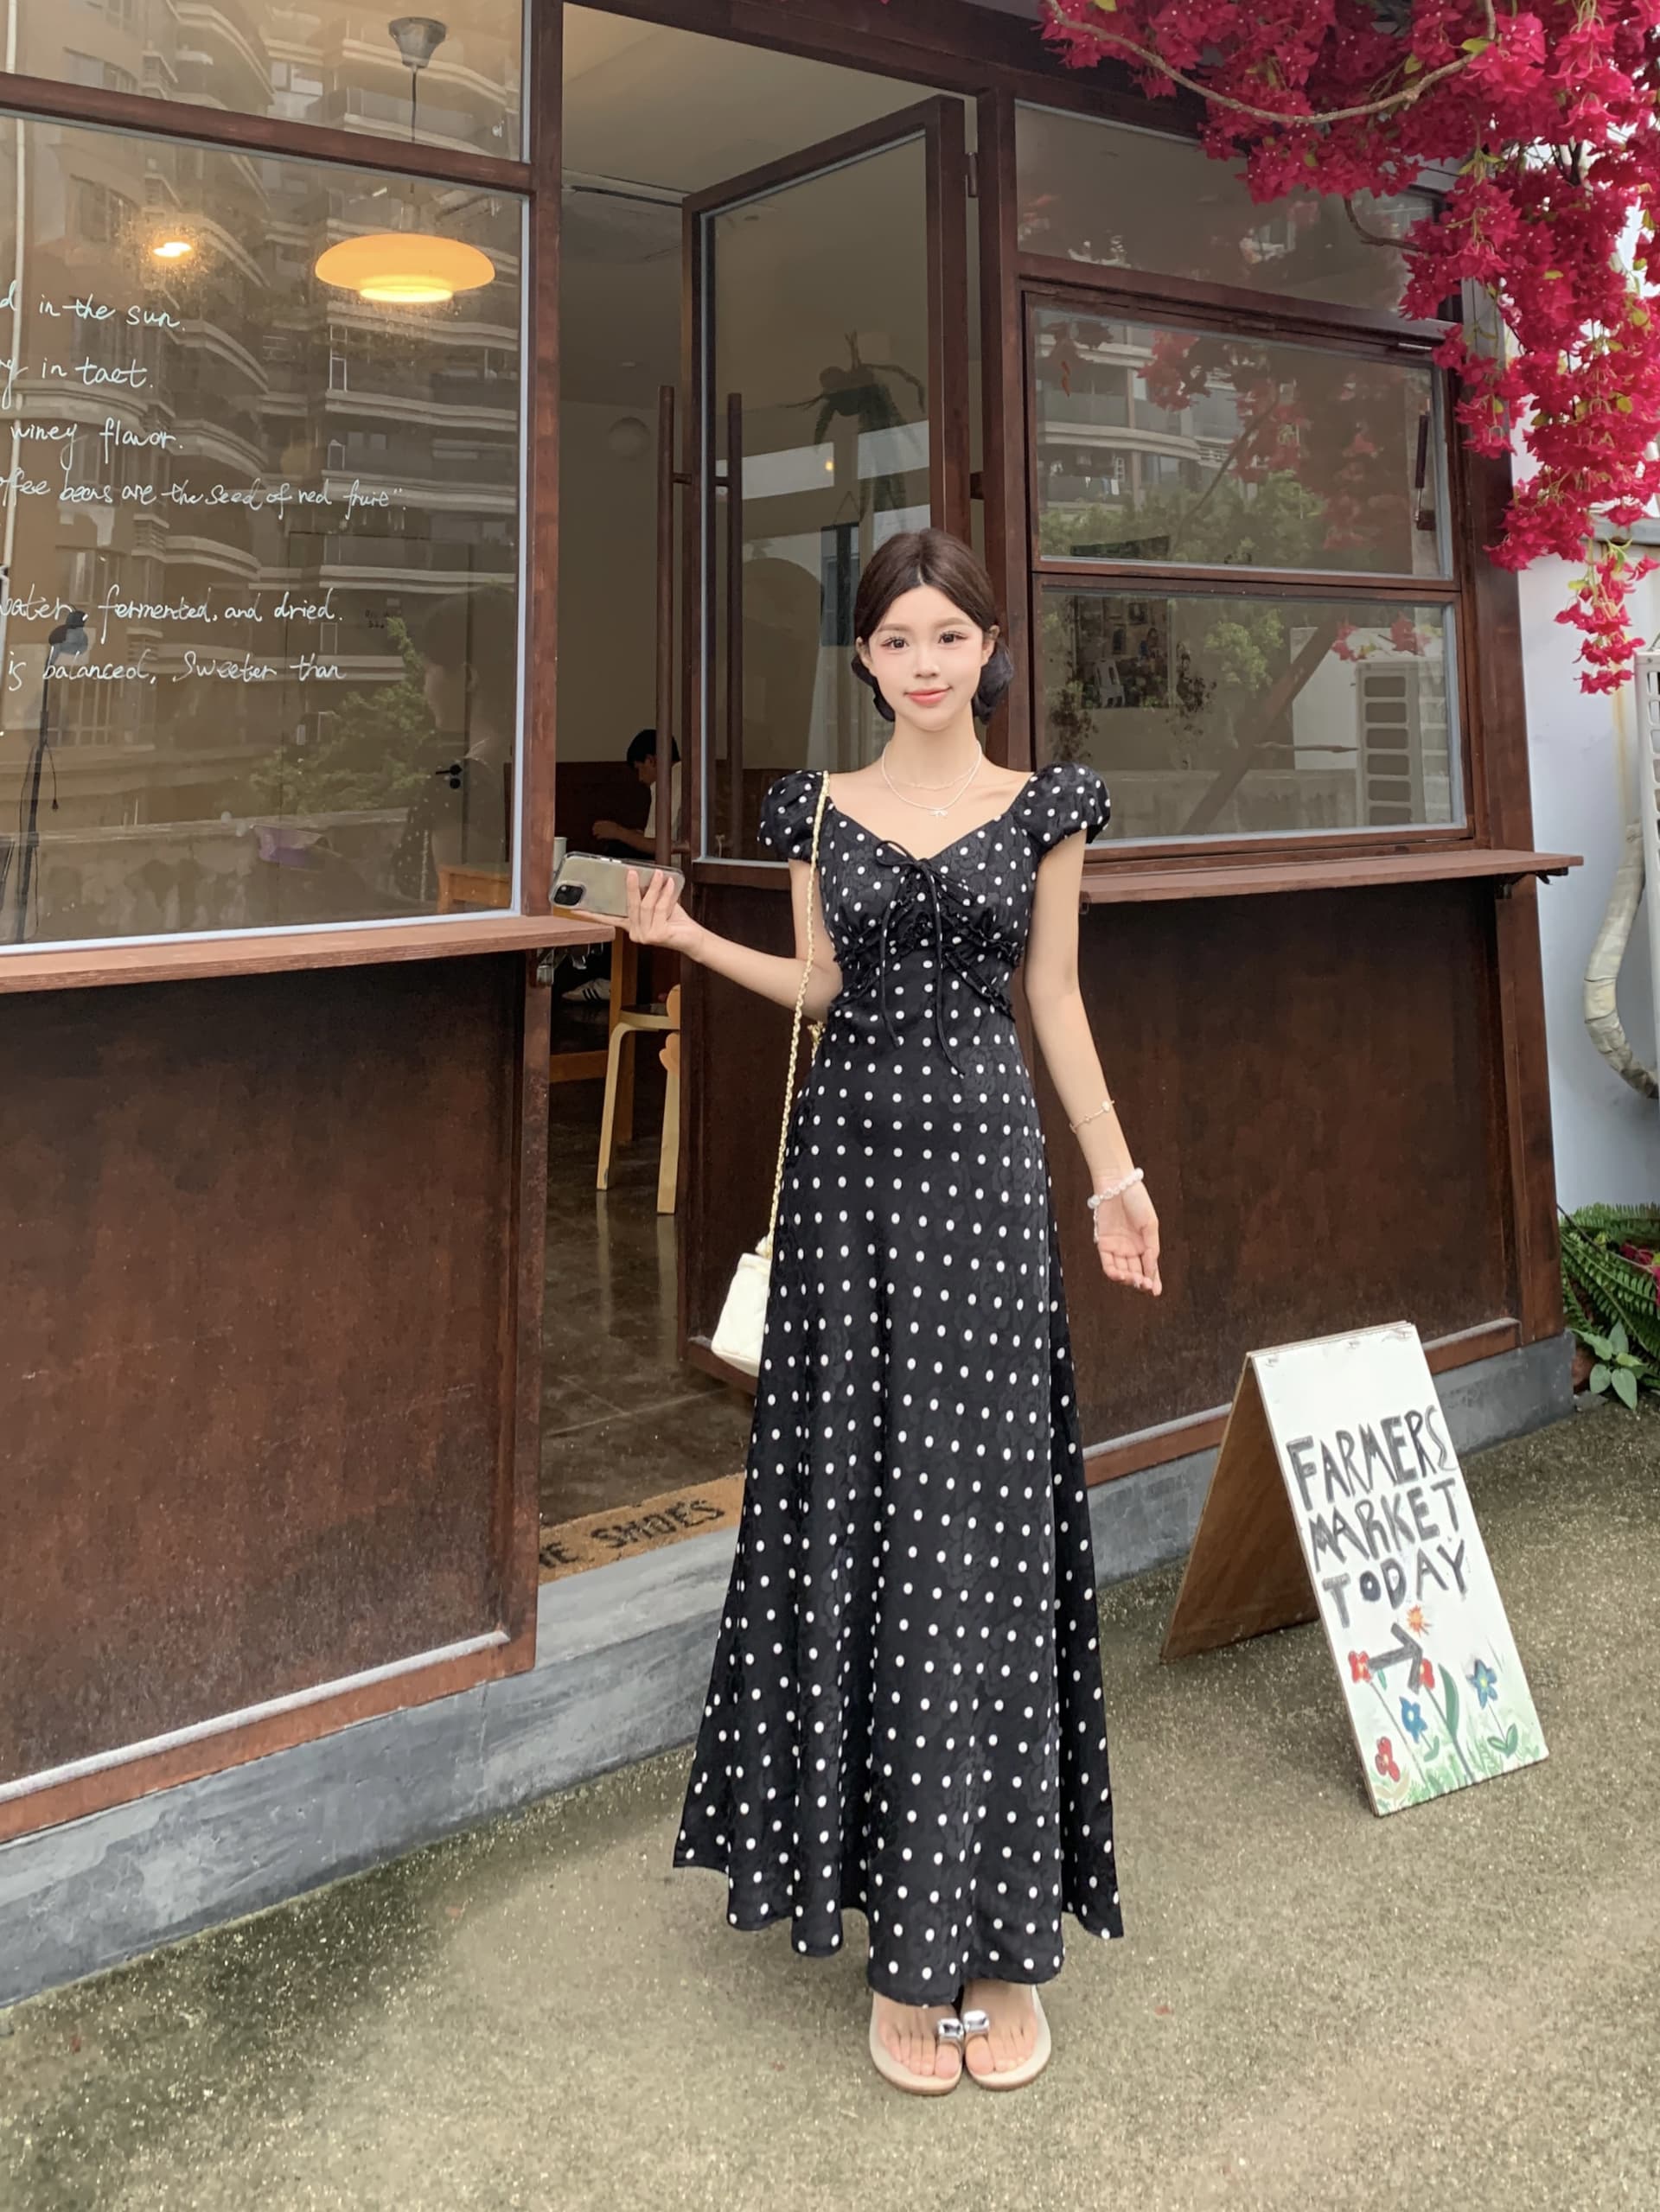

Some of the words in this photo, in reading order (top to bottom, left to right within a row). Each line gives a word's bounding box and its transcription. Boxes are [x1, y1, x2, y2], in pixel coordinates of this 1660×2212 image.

[39, 294, 61, 316] in
[62, 293, 115, 320] the
[42, 357, 67, 379] in
[99, 418, 183, 464] flavor.
[121, 484, 156, 506] are
[266, 483, 292, 520] of
[298, 478, 332, 505] red
[225, 592, 263, 622] and
[274, 587, 343, 621] dried.
[9, 651, 27, 692] is
[290, 653, 346, 682] than
[1286, 1405, 1457, 1513] FARMERS
[591, 1499, 725, 1548] SHOES
[1306, 1477, 1460, 1573] MARKET
[1323, 1539, 1467, 1629] TODAY
